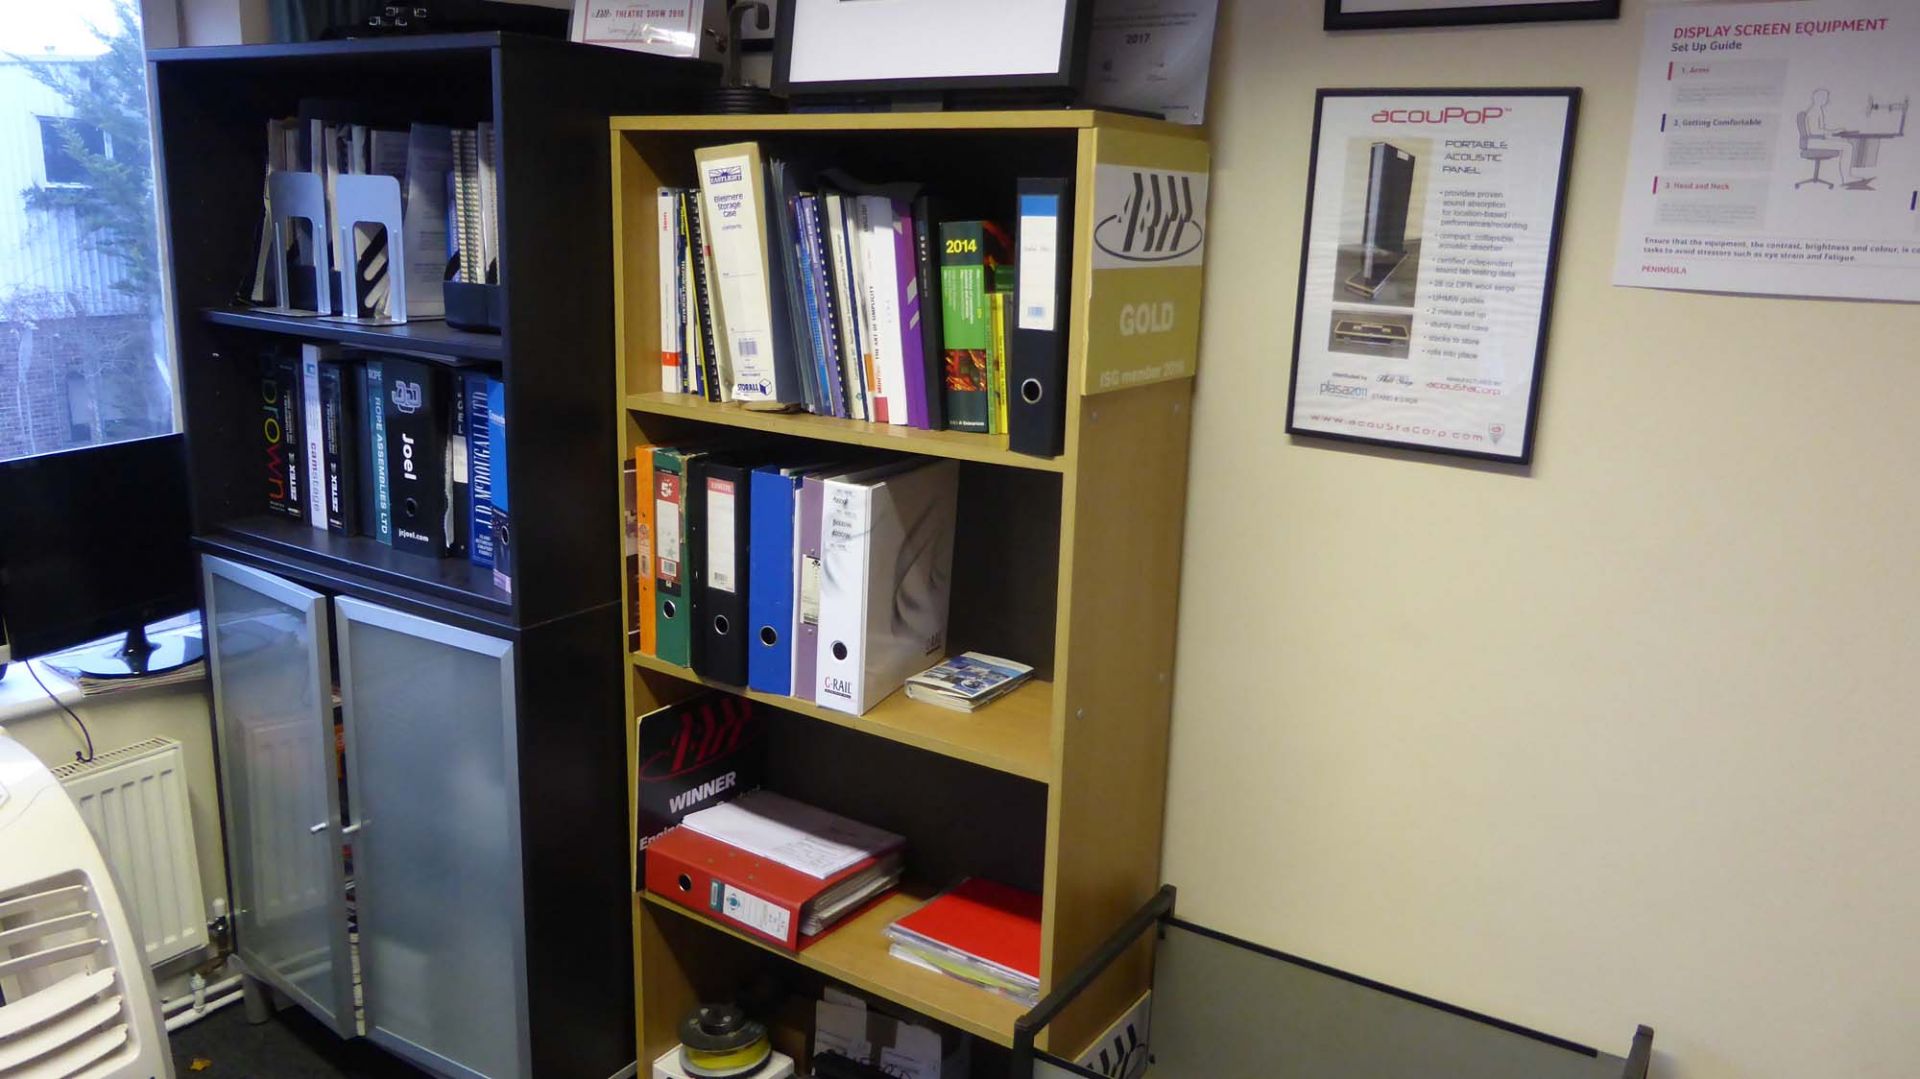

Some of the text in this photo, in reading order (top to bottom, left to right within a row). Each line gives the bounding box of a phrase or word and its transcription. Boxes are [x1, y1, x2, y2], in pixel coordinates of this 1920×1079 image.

[1673, 17, 1889, 40] DISPLAY SCREEN EQUIPMENT
[1125, 32, 1151, 45] 2017
[1671, 40, 1743, 54] Set Up Guide
[1682, 119, 1711, 129] Getting
[1713, 118, 1763, 127] Comfortable
[1444, 139, 1509, 150] PORTABLE
[1443, 152, 1503, 162] ACOUSTIC
[1441, 165, 1481, 175] PANEL
[1674, 182, 1694, 190] Head
[1695, 183, 1710, 191] and
[946, 240, 977, 253] 2014
[1643, 246, 1663, 254] tasks
[1665, 247, 1673, 255] to
[1675, 248, 1696, 256] avoid
[1697, 249, 1732, 257] stressors
[1733, 249, 1752, 258] such
[1764, 252, 1779, 260] eye
[1780, 252, 1805, 260] strain
[1806, 252, 1823, 260] and
[1645, 237, 1670, 245] Ensure
[1672, 237, 1688, 246] that
[1690, 238, 1703, 246] the
[1751, 241, 1764, 249] the
[1766, 241, 1802, 250] contrast,
[1805, 242, 1850, 252] brightness
[1852, 244, 1868, 252] and
[1870, 244, 1900, 254] colour,
[1902, 246, 1909, 254] is
[1640, 264, 1688, 275] PENINSULA
[1120, 302, 1175, 337] GOLD
[1121, 366, 1163, 385] member
[472, 391, 488, 419] LTD
[402, 432, 417, 480] Joel
[376, 433, 388, 510] ASSEMBLIES
[288, 463, 297, 502] ZETEX
[330, 474, 339, 514] ZETEX
[381, 512, 389, 534] LTD
[824, 676, 852, 694] C-RAIL
[669, 771, 736, 814] WINNER
